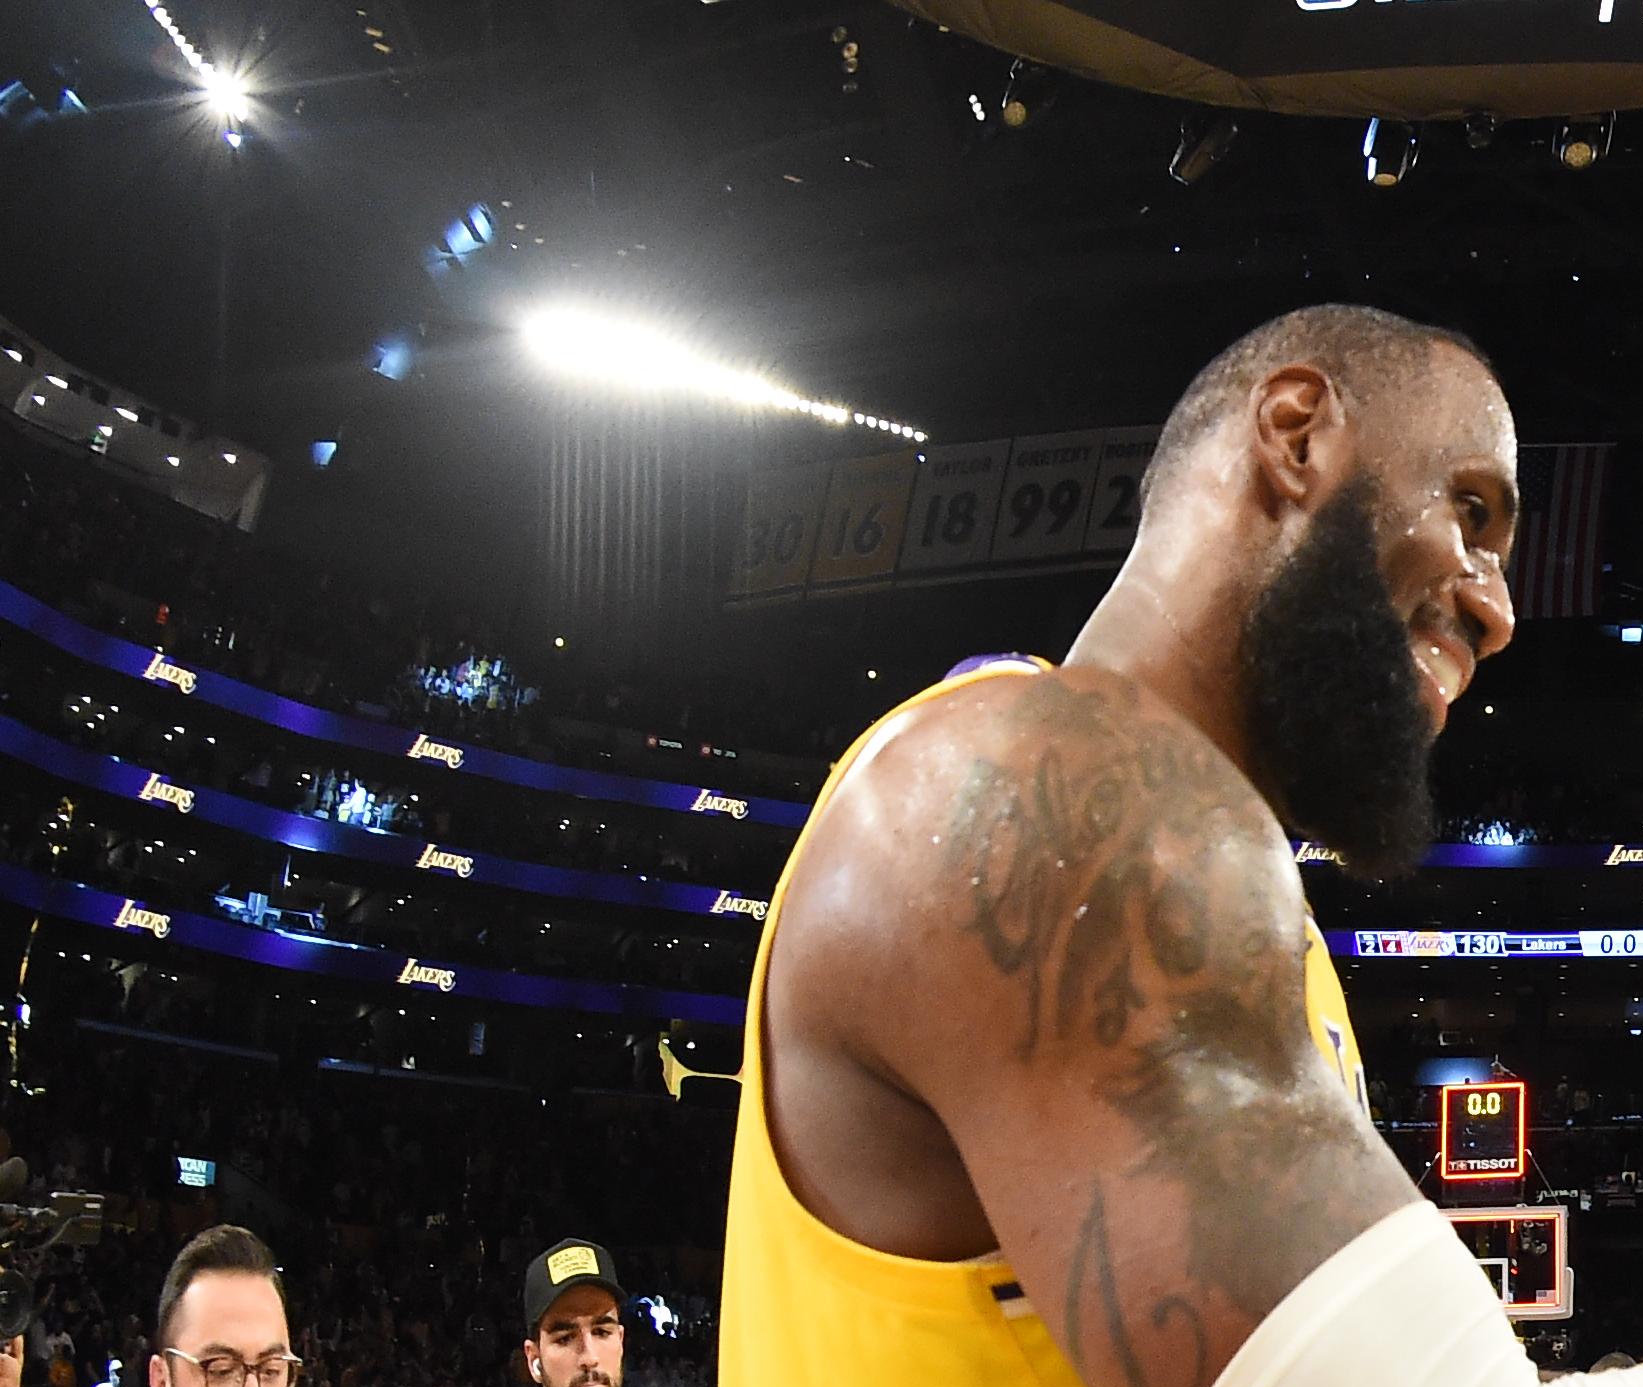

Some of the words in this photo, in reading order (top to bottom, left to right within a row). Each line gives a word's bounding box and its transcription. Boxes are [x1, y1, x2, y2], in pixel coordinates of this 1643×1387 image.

[921, 492, 978, 547] 18
[1010, 480, 1081, 538] 99
[831, 503, 886, 557] 16
[143, 653, 197, 694] LAKERS
[407, 734, 464, 768] LAKERS
[138, 773, 194, 813] LAKERS
[690, 789, 748, 819] LAKERS
[416, 844, 473, 878] LAKERS
[113, 899, 170, 938] LAKERS
[710, 890, 768, 921] LAKERS
[1460, 935, 1499, 954] 130
[1521, 938, 1567, 951] Lakers
[1600, 934, 1637, 954] 0.0
[397, 958, 456, 992] LAKERS
[1467, 1092, 1501, 1116] 0.0
[1468, 1157, 1518, 1170] TISSOT
